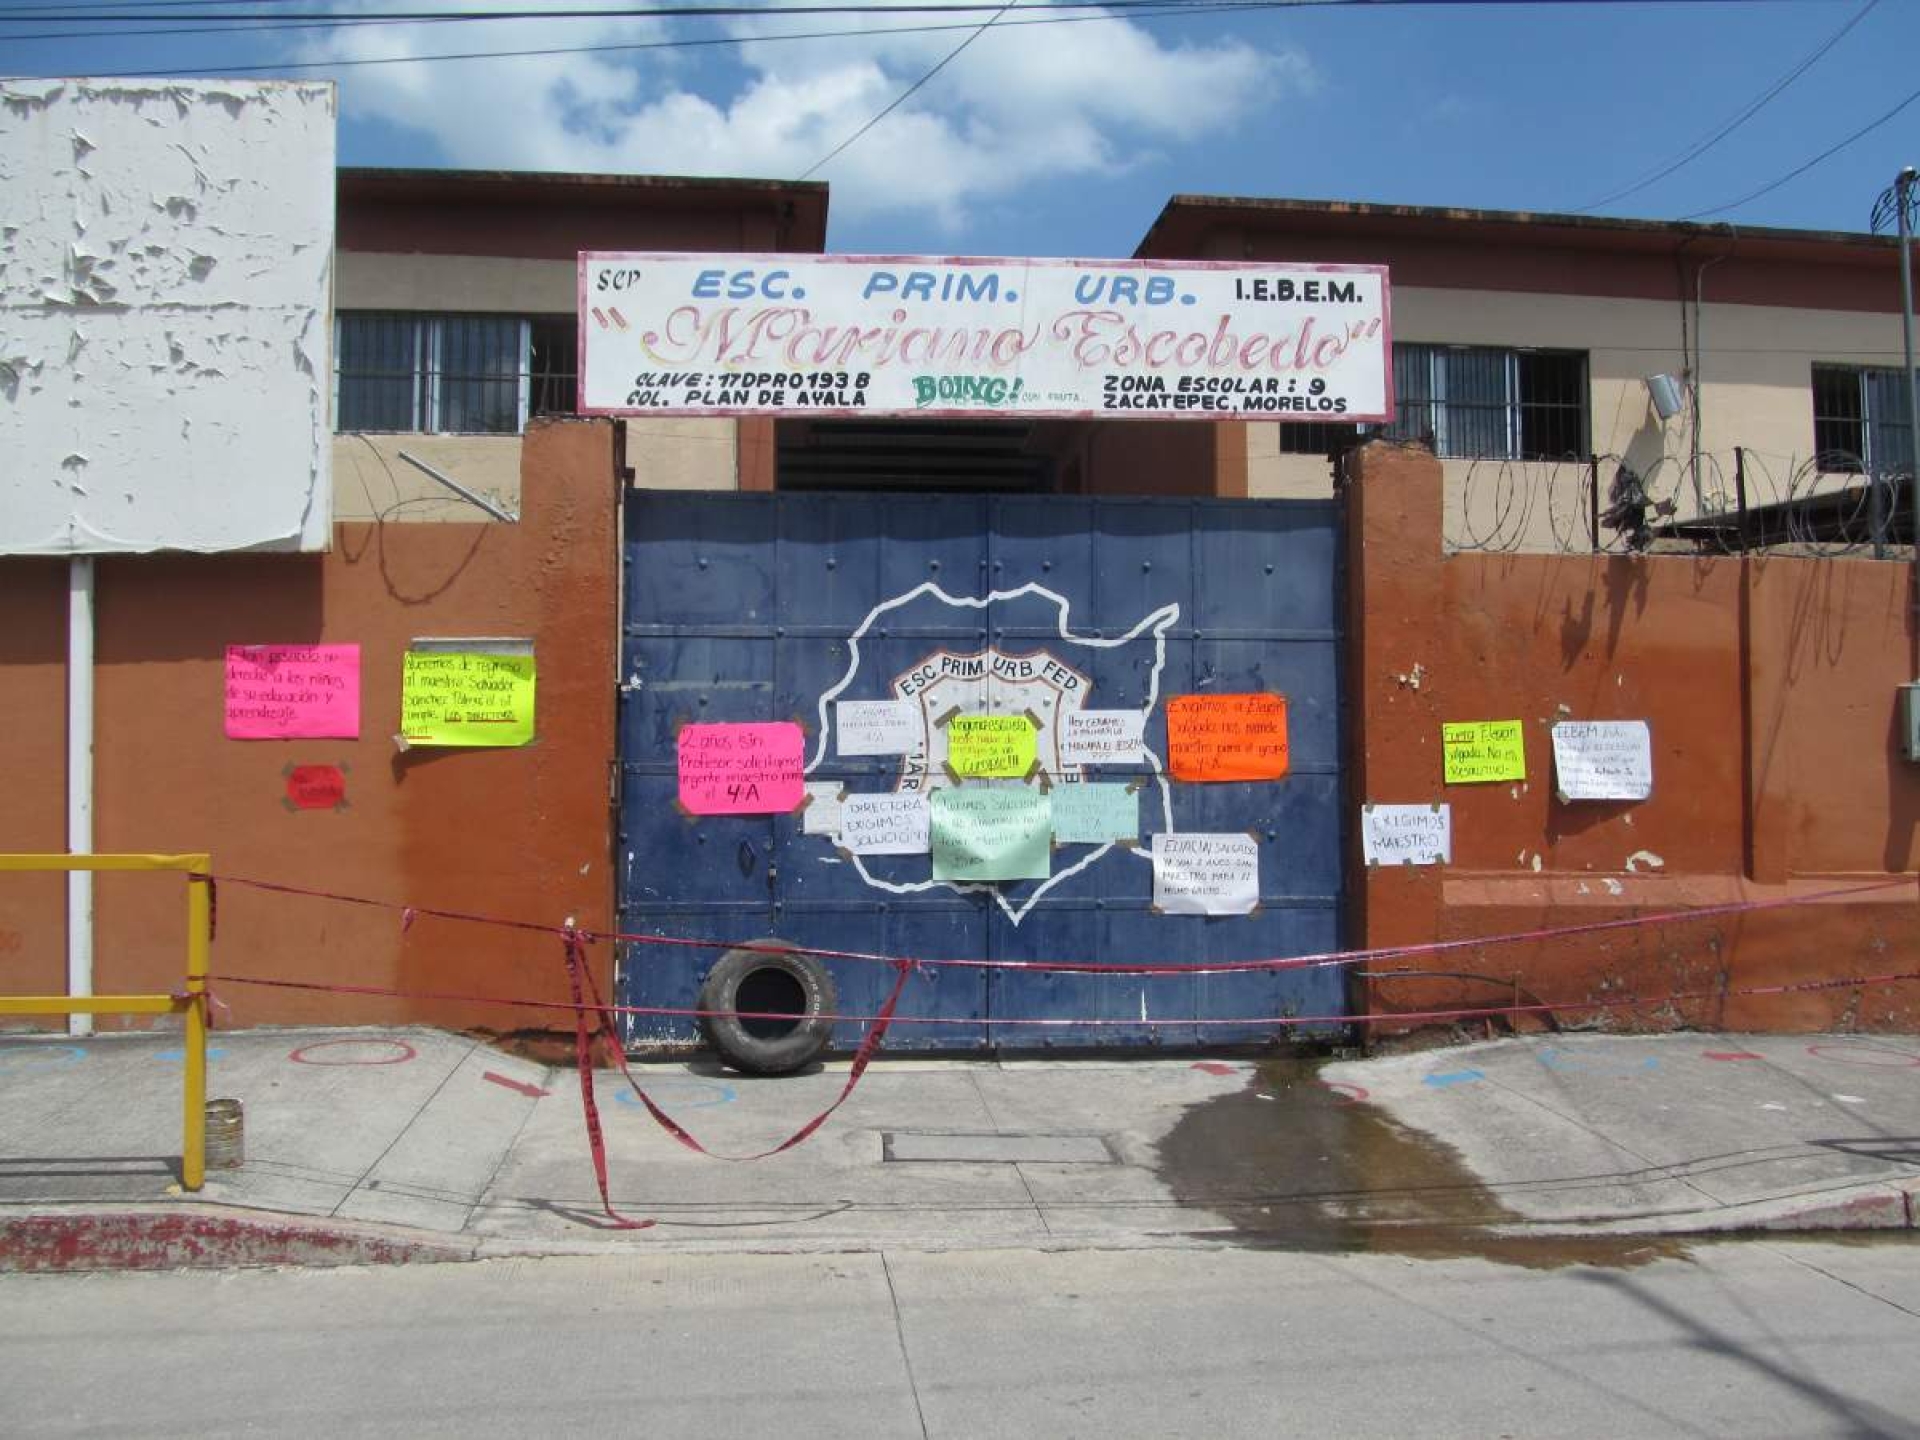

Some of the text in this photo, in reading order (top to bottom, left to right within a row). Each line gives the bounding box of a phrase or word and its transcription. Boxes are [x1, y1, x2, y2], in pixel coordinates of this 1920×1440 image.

[691, 269, 1198, 305] ESC. PRIM. URB.
[1235, 278, 1363, 303] I.E.B.E.M.
[912, 375, 1024, 409] BOING!
[1103, 375, 1167, 393] ZONA
[1307, 378, 1326, 395] 9
[626, 390, 866, 408] COL. PLAN DE AYALA
[1243, 396, 1347, 413] MORELOS
[1372, 833, 1440, 851] MAESTRO
